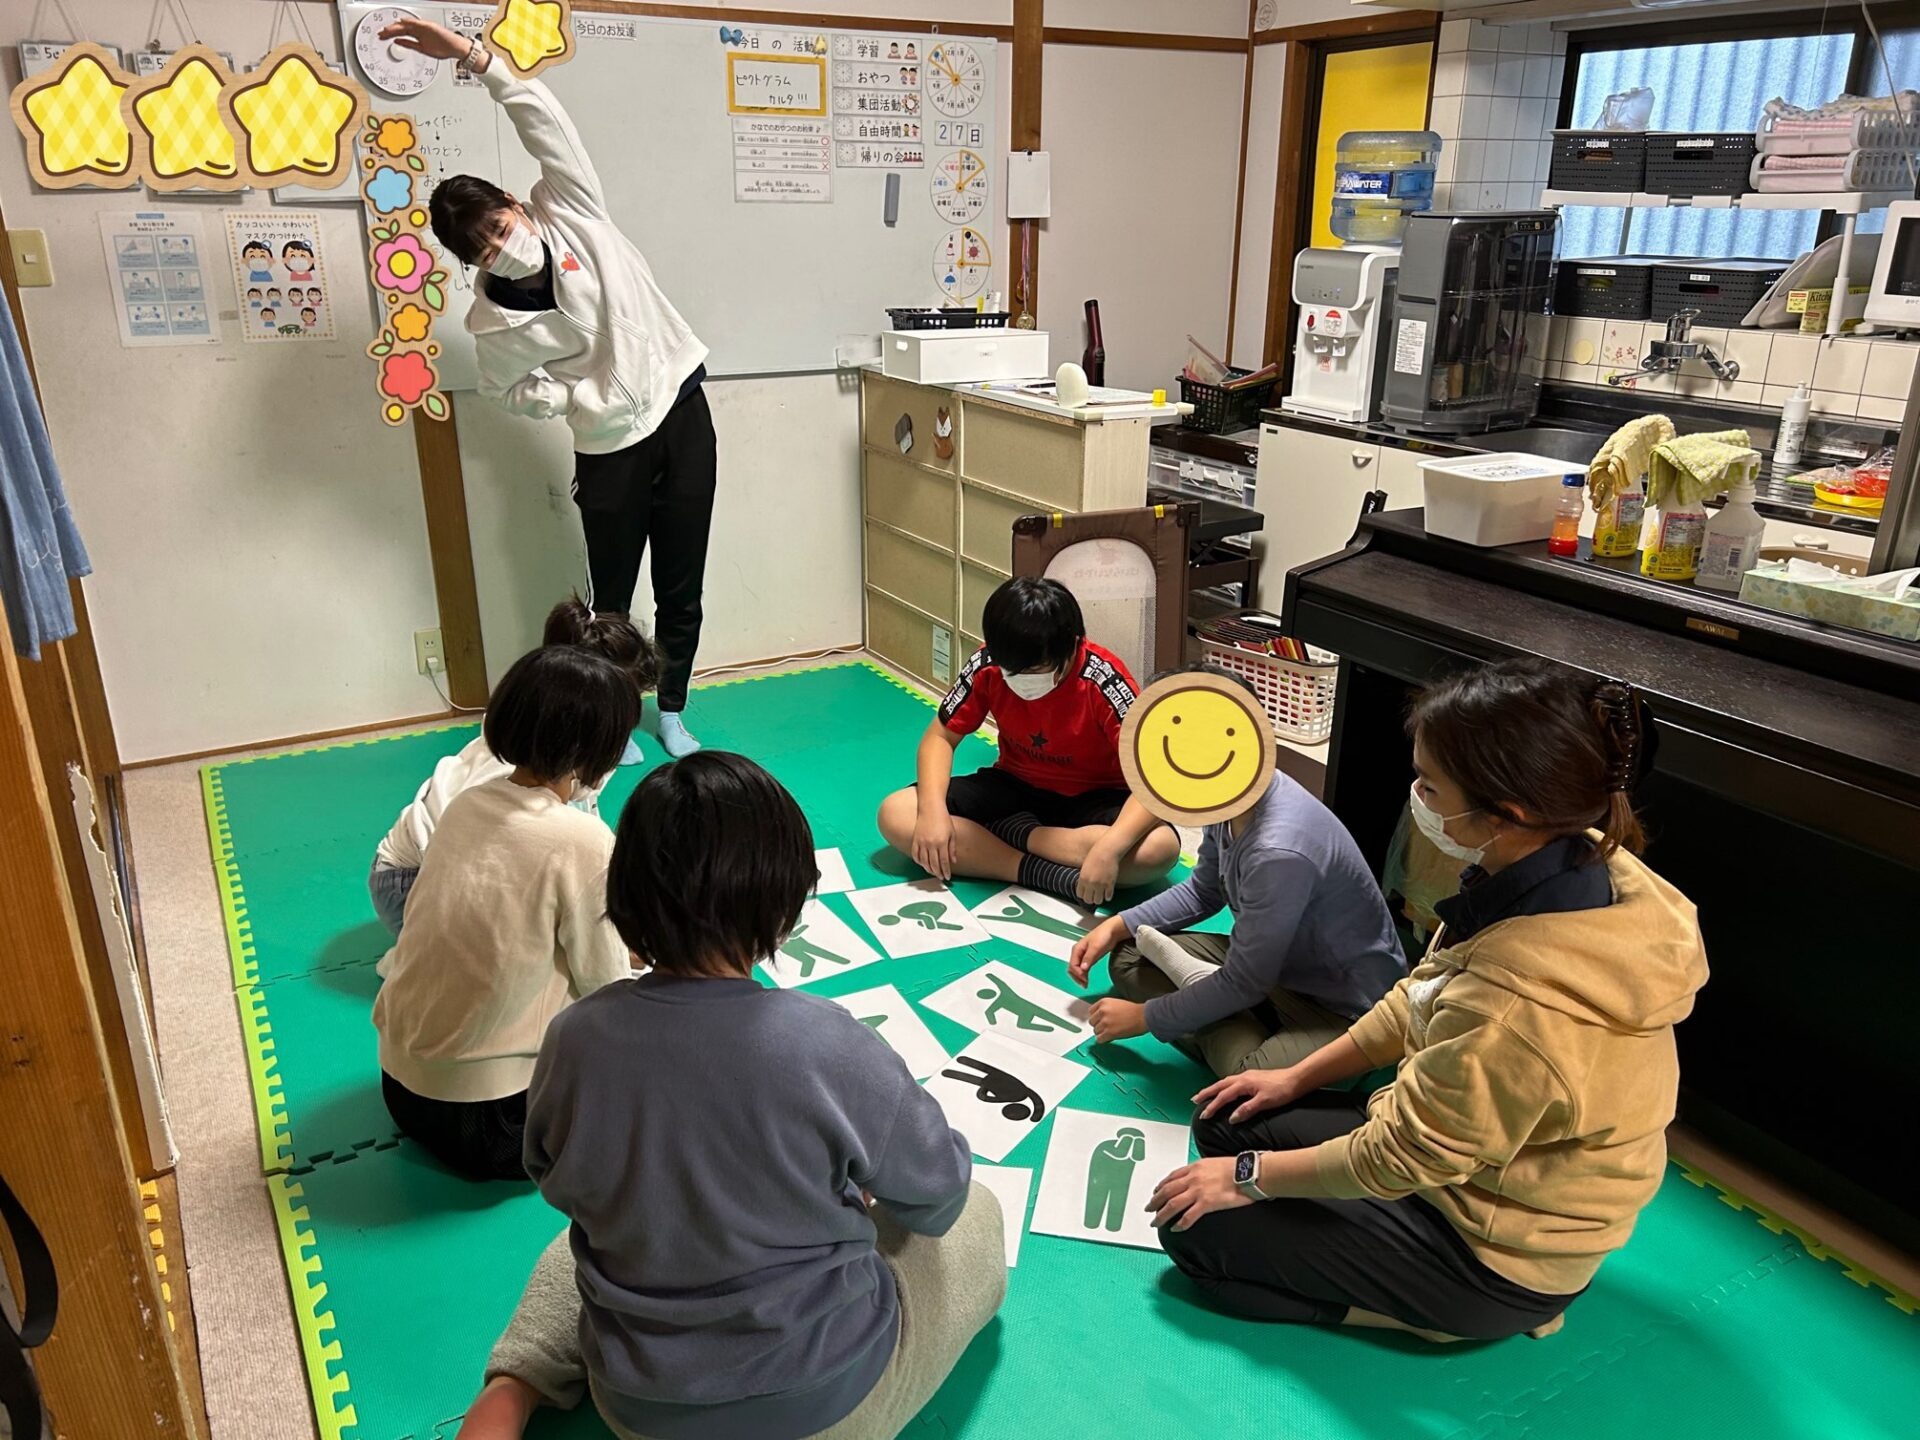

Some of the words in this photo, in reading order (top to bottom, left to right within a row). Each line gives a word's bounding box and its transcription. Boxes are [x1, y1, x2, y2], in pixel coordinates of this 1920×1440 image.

[577, 23, 636, 38] 今日のお友達
[741, 36, 759, 49] 今日
[772, 40, 782, 50] の
[858, 45, 879, 58] 学習
[736, 74, 792, 87] ピクトグラム
[858, 72, 890, 84] おやつ
[858, 97, 902, 112] 集団活動
[859, 125, 902, 138] 自由時間
[861, 151, 904, 163] 帰りの会
